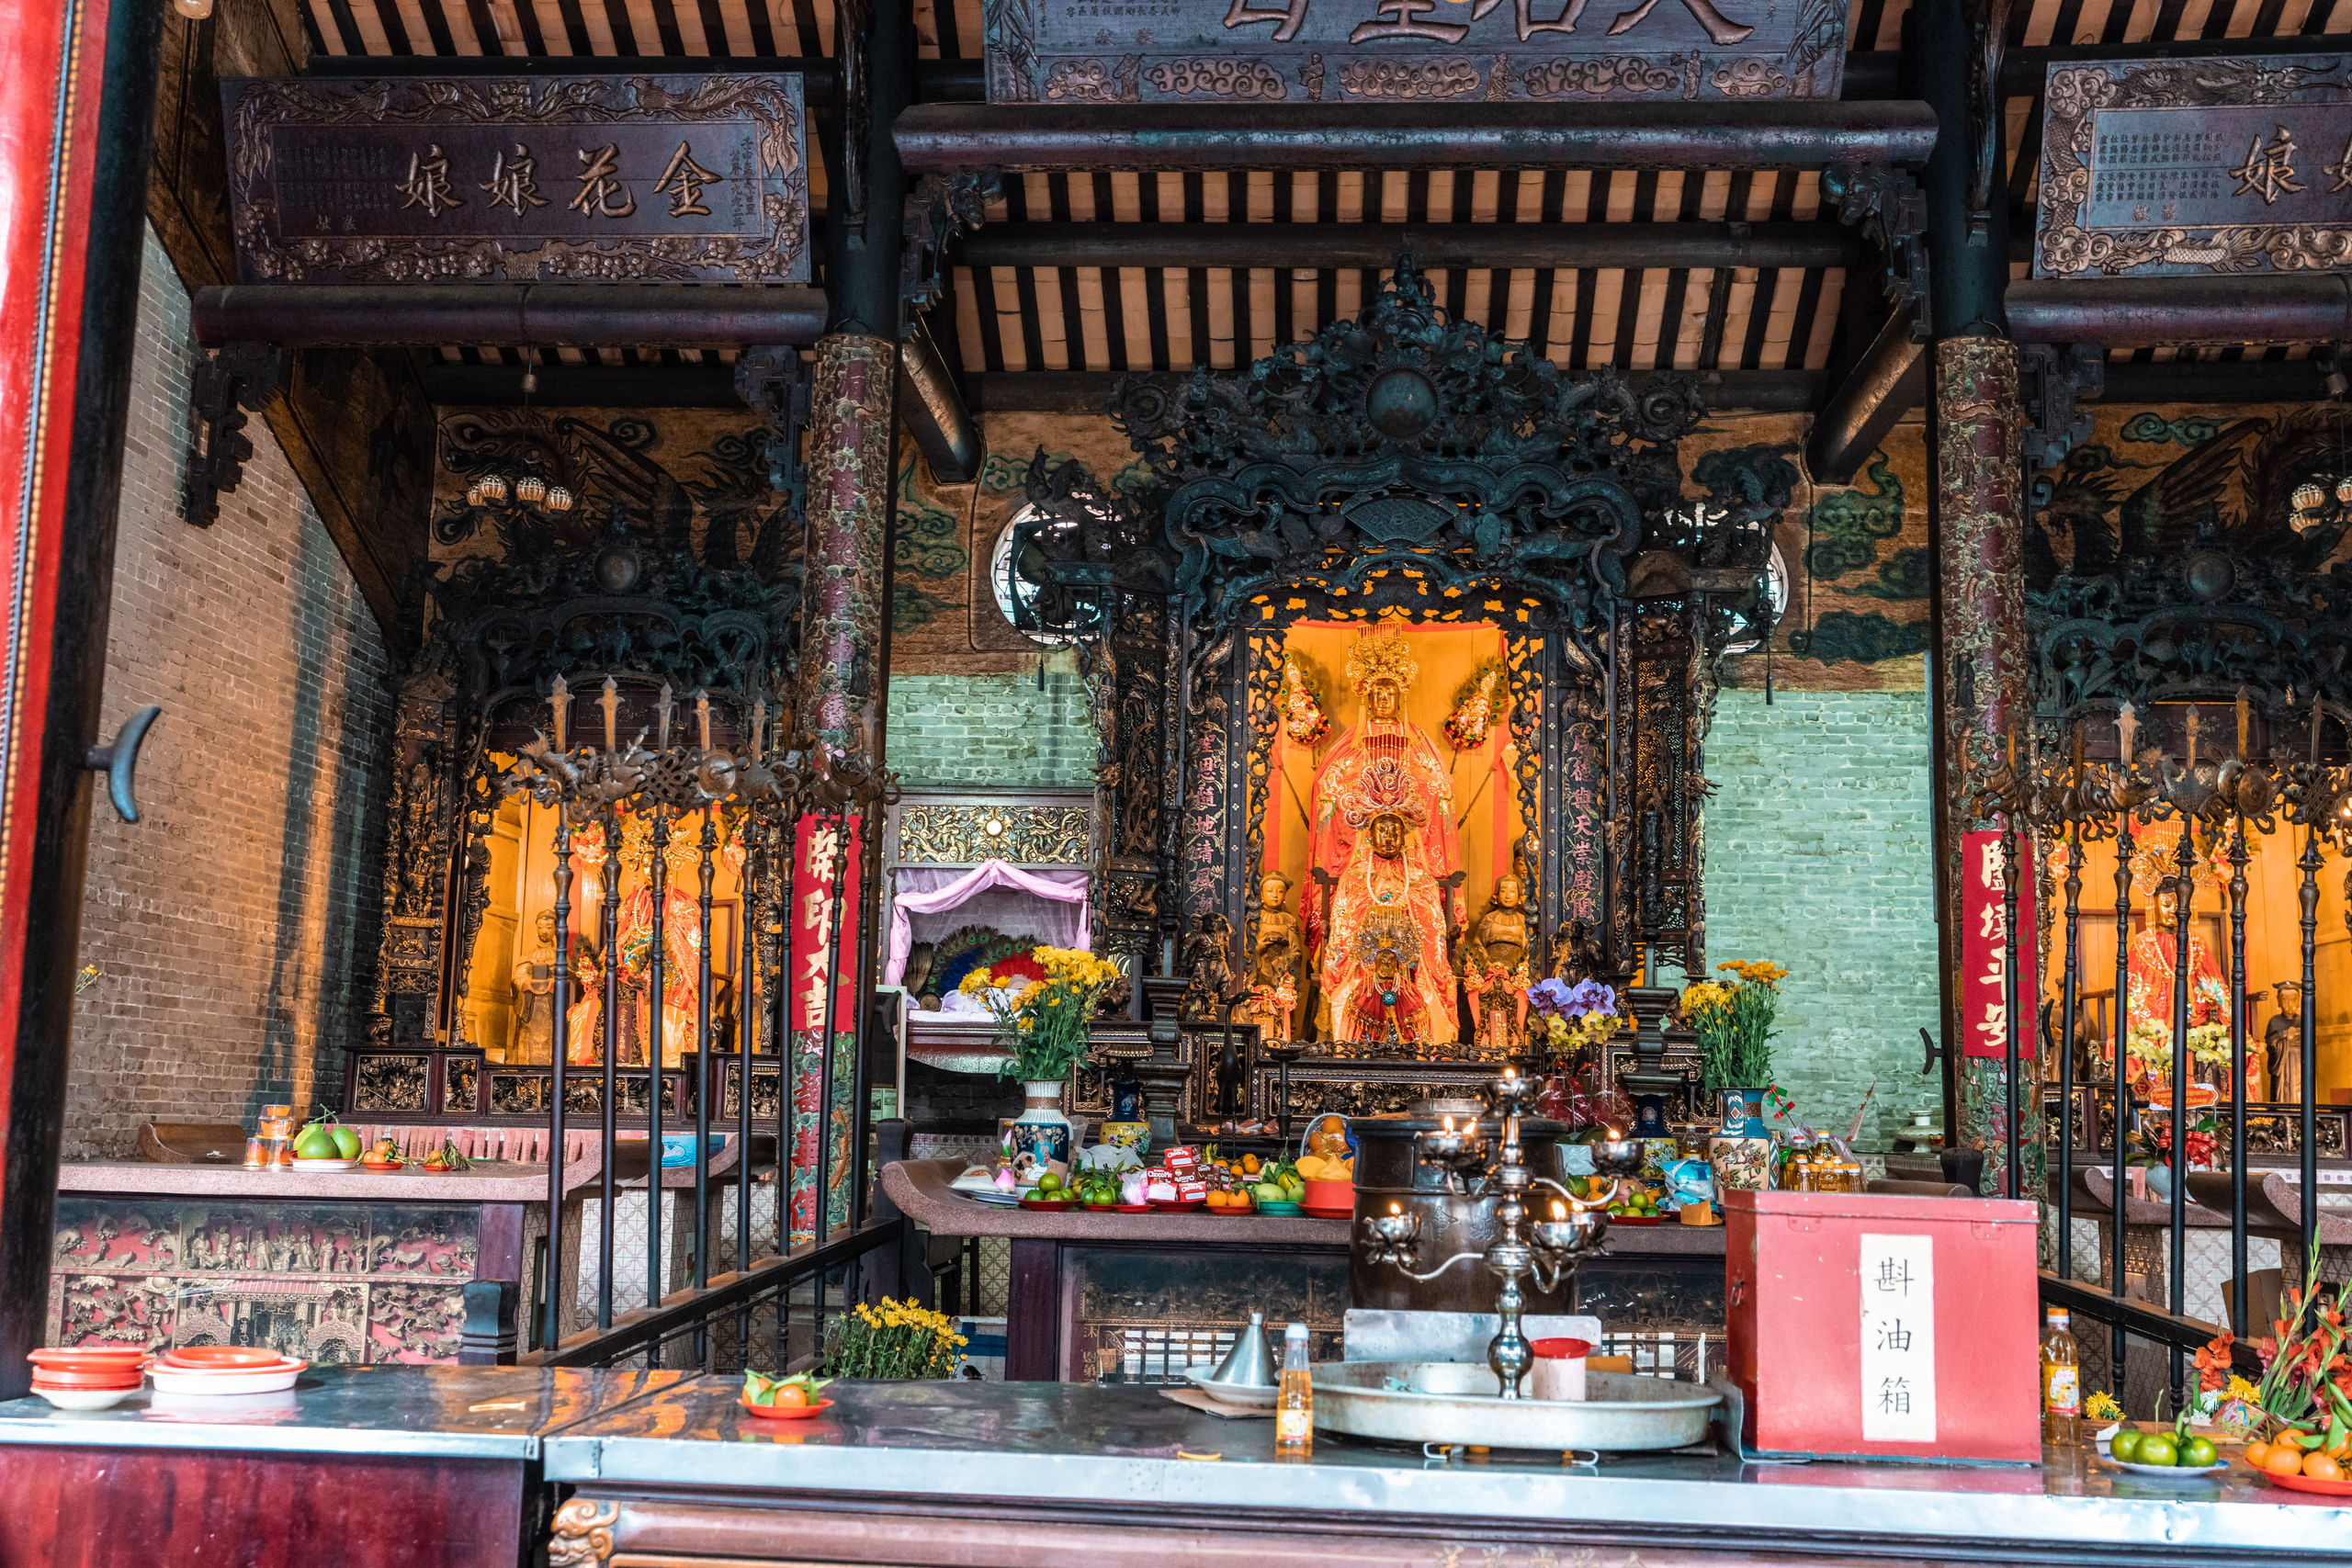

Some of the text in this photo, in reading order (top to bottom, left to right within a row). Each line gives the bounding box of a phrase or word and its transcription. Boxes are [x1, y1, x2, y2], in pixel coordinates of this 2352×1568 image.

[394, 141, 724, 219] 金花娘娘
[1873, 1257, 1916, 1415] 斟油箱
